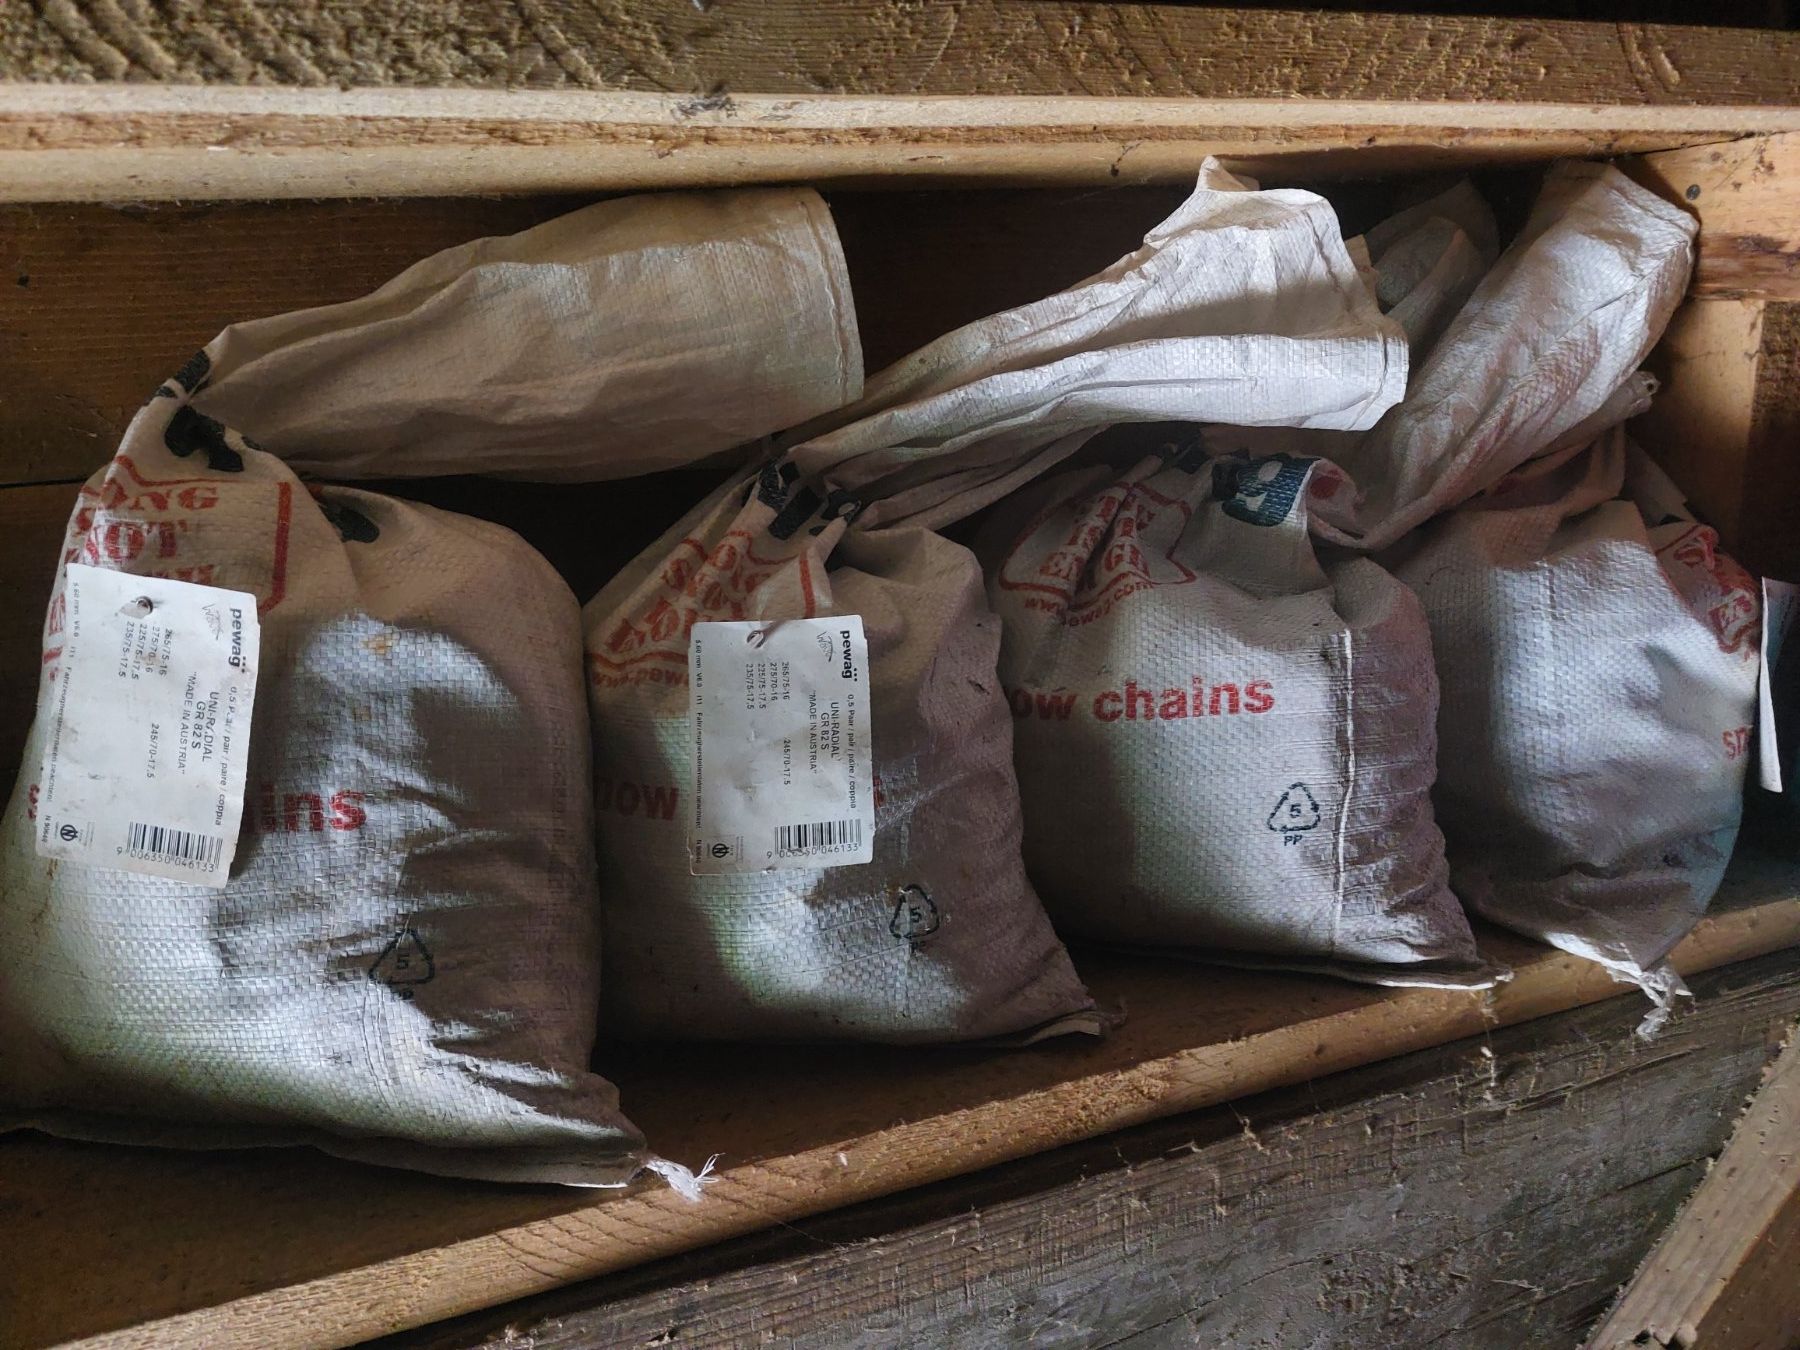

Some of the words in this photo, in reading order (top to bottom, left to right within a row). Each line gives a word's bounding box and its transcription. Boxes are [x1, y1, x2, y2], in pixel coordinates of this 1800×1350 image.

[228, 608, 247, 674] pewag
[840, 630, 857, 682] pewag
[1092, 674, 1275, 723] chains
[182, 709, 193, 722] IN
[195, 700, 205, 721] GR
[848, 709, 856, 726] Paar
[809, 722, 816, 731] IN
[821, 712, 830, 727] GR
[192, 723, 203, 739] 82
[821, 730, 830, 741] 82
[831, 702, 840, 758] UNI-RADIAL
[191, 740, 202, 750] S
[221, 735, 233, 755] pair
[821, 742, 830, 750] S
[846, 733, 855, 747] pair
[219, 762, 230, 786] paire
[848, 781, 857, 808] coppia
[214, 794, 226, 826] coppia
[1289, 803, 1302, 819] 5
[1283, 834, 1303, 847] PP
[910, 906, 922, 924] 5
